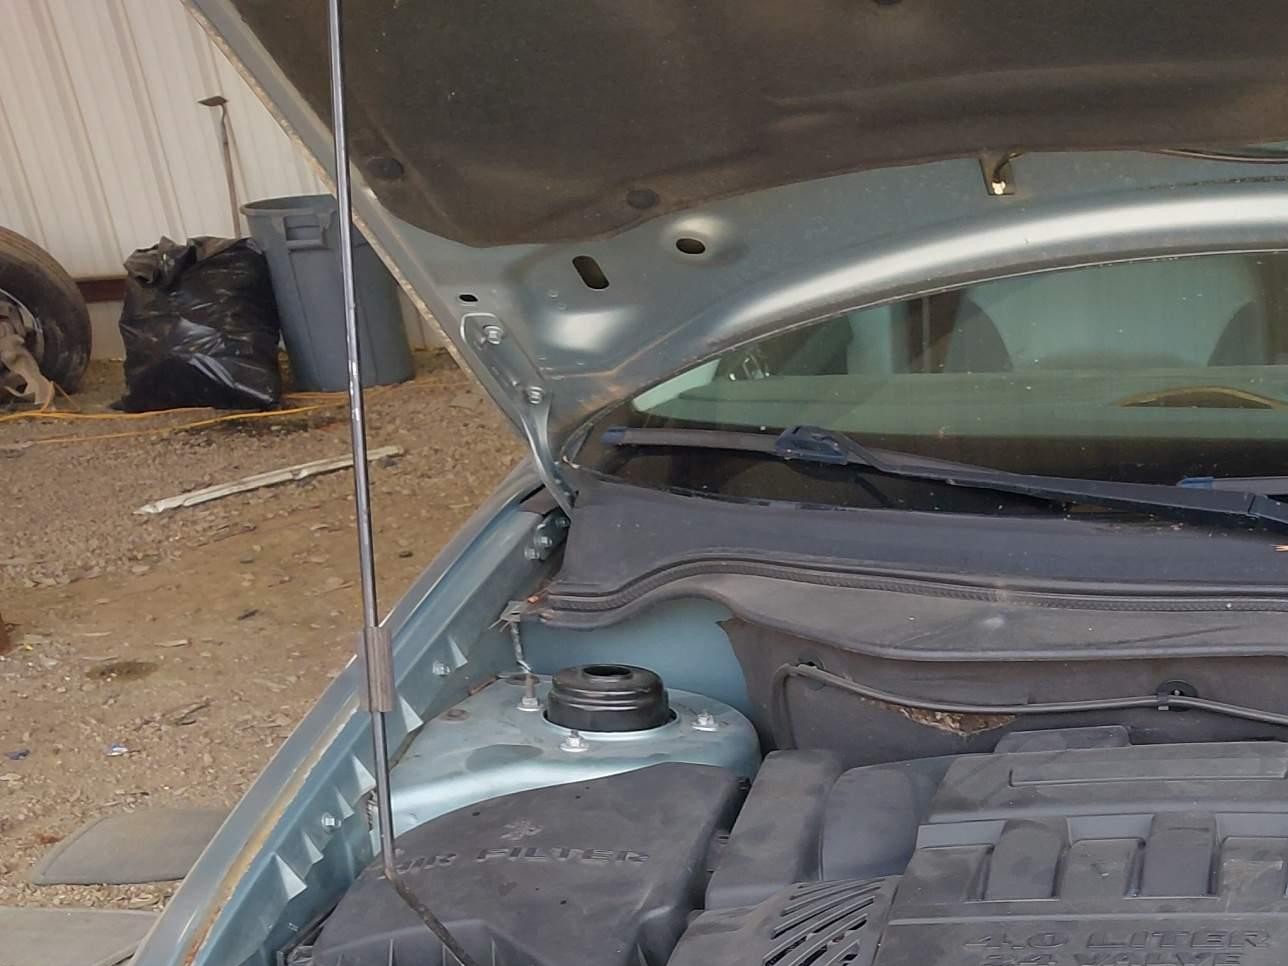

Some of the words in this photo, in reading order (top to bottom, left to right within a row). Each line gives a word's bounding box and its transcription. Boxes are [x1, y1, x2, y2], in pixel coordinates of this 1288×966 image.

[475, 847, 650, 864] FILTER
[963, 931, 1071, 950] 4.0
[1086, 930, 1271, 949] LITER
